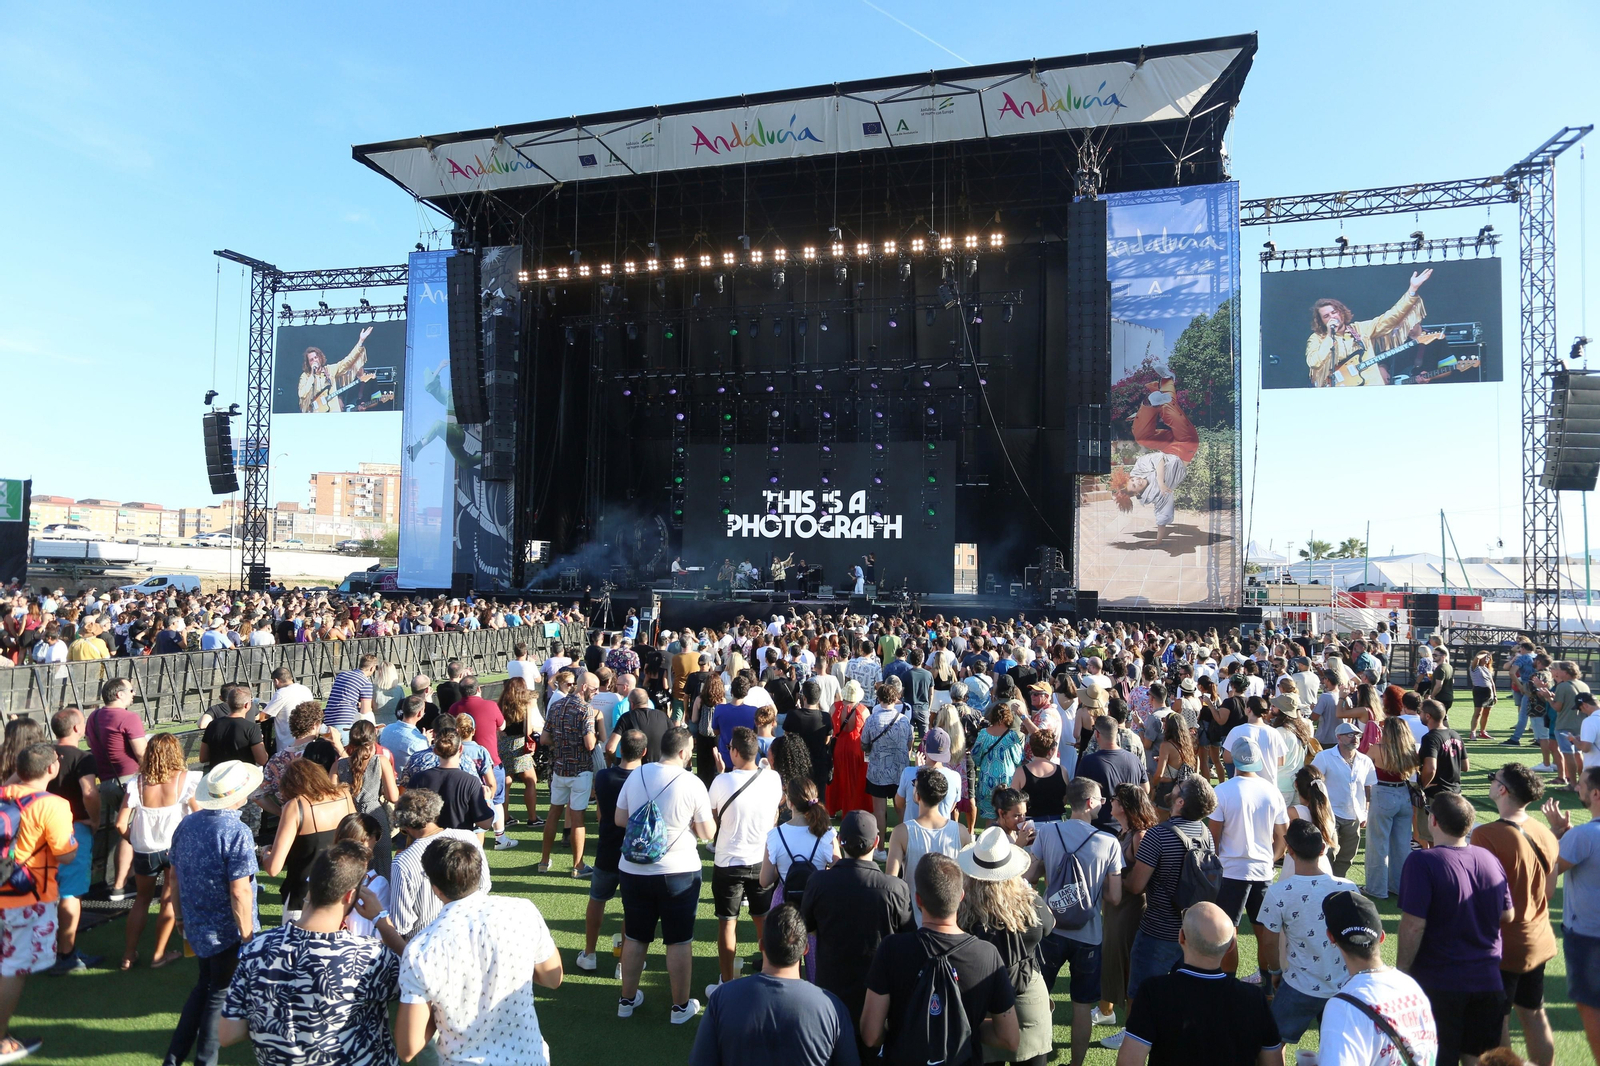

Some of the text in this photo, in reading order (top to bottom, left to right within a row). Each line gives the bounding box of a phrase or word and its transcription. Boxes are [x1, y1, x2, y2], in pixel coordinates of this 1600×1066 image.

[997, 80, 1128, 120] Andalucía
[690, 113, 824, 155] Andalucía
[446, 149, 541, 180] Andalucía
[762, 489, 866, 514] THIS IS A
[727, 514, 903, 539] PHOTOGRAPH
